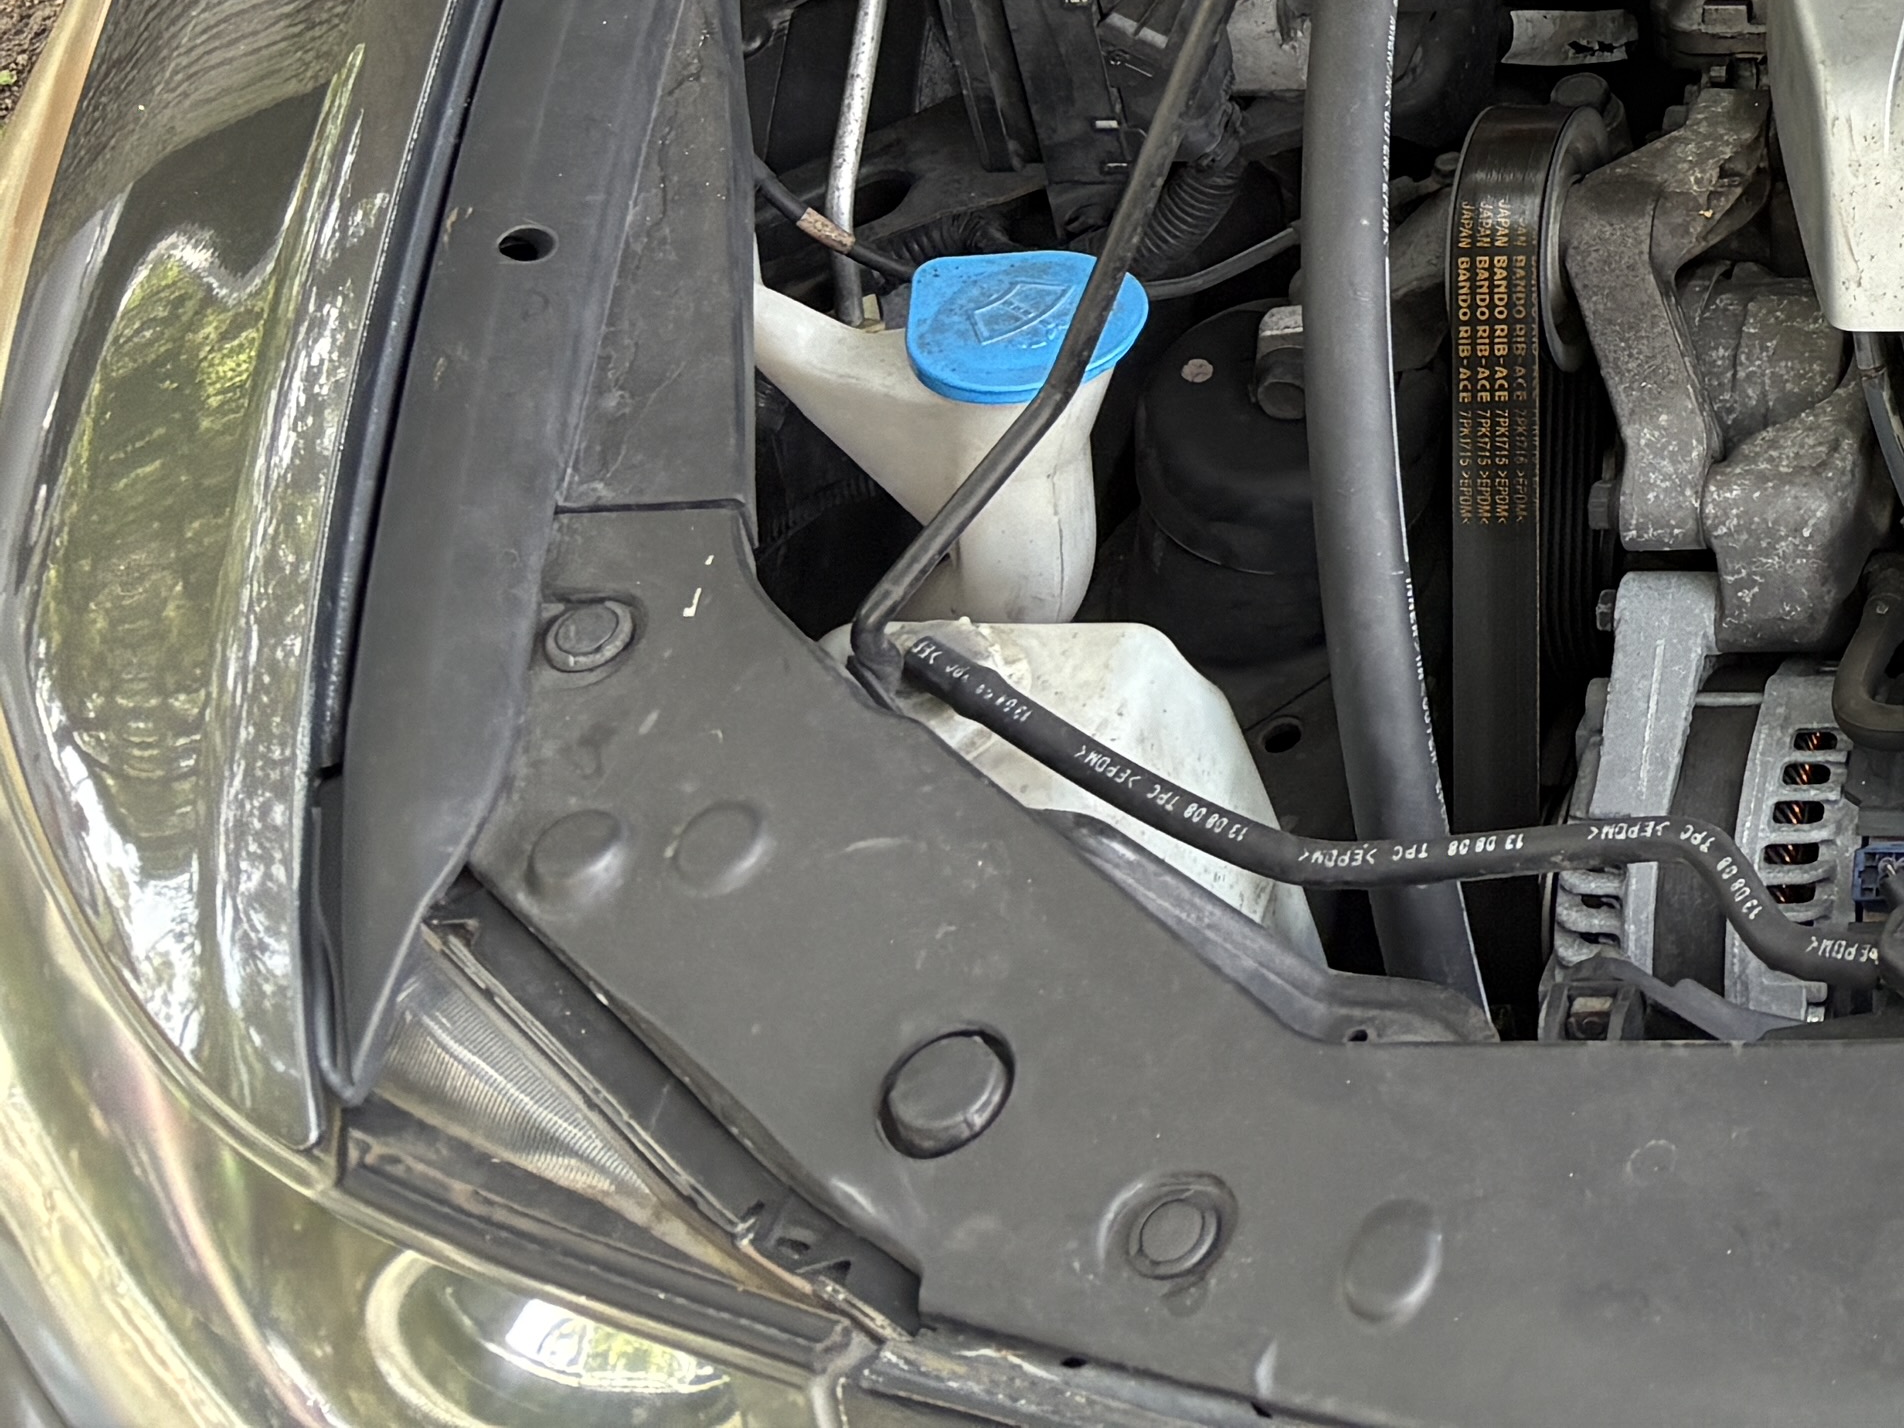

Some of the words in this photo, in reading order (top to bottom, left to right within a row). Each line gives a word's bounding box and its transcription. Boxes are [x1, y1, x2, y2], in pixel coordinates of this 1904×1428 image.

[1457, 200, 1473, 248] JAPAN
[1493, 200, 1511, 248] JAPAN
[1457, 256, 1473, 321] BANDO
[1476, 256, 1491, 321] BANDO
[1493, 256, 1511, 321] BANDO
[1457, 324, 1473, 403] RIB-ACE
[1476, 324, 1491, 403] RIB-ACE
[1493, 324, 1511, 403] RIB-ACE
[1493, 409, 1511, 466] 7PK1715
[1145, 785, 1179, 812] TPC
[1228, 824, 1249, 842] 13
[1391, 842, 1428, 861] TPC
[1505, 834, 1525, 850] 13
